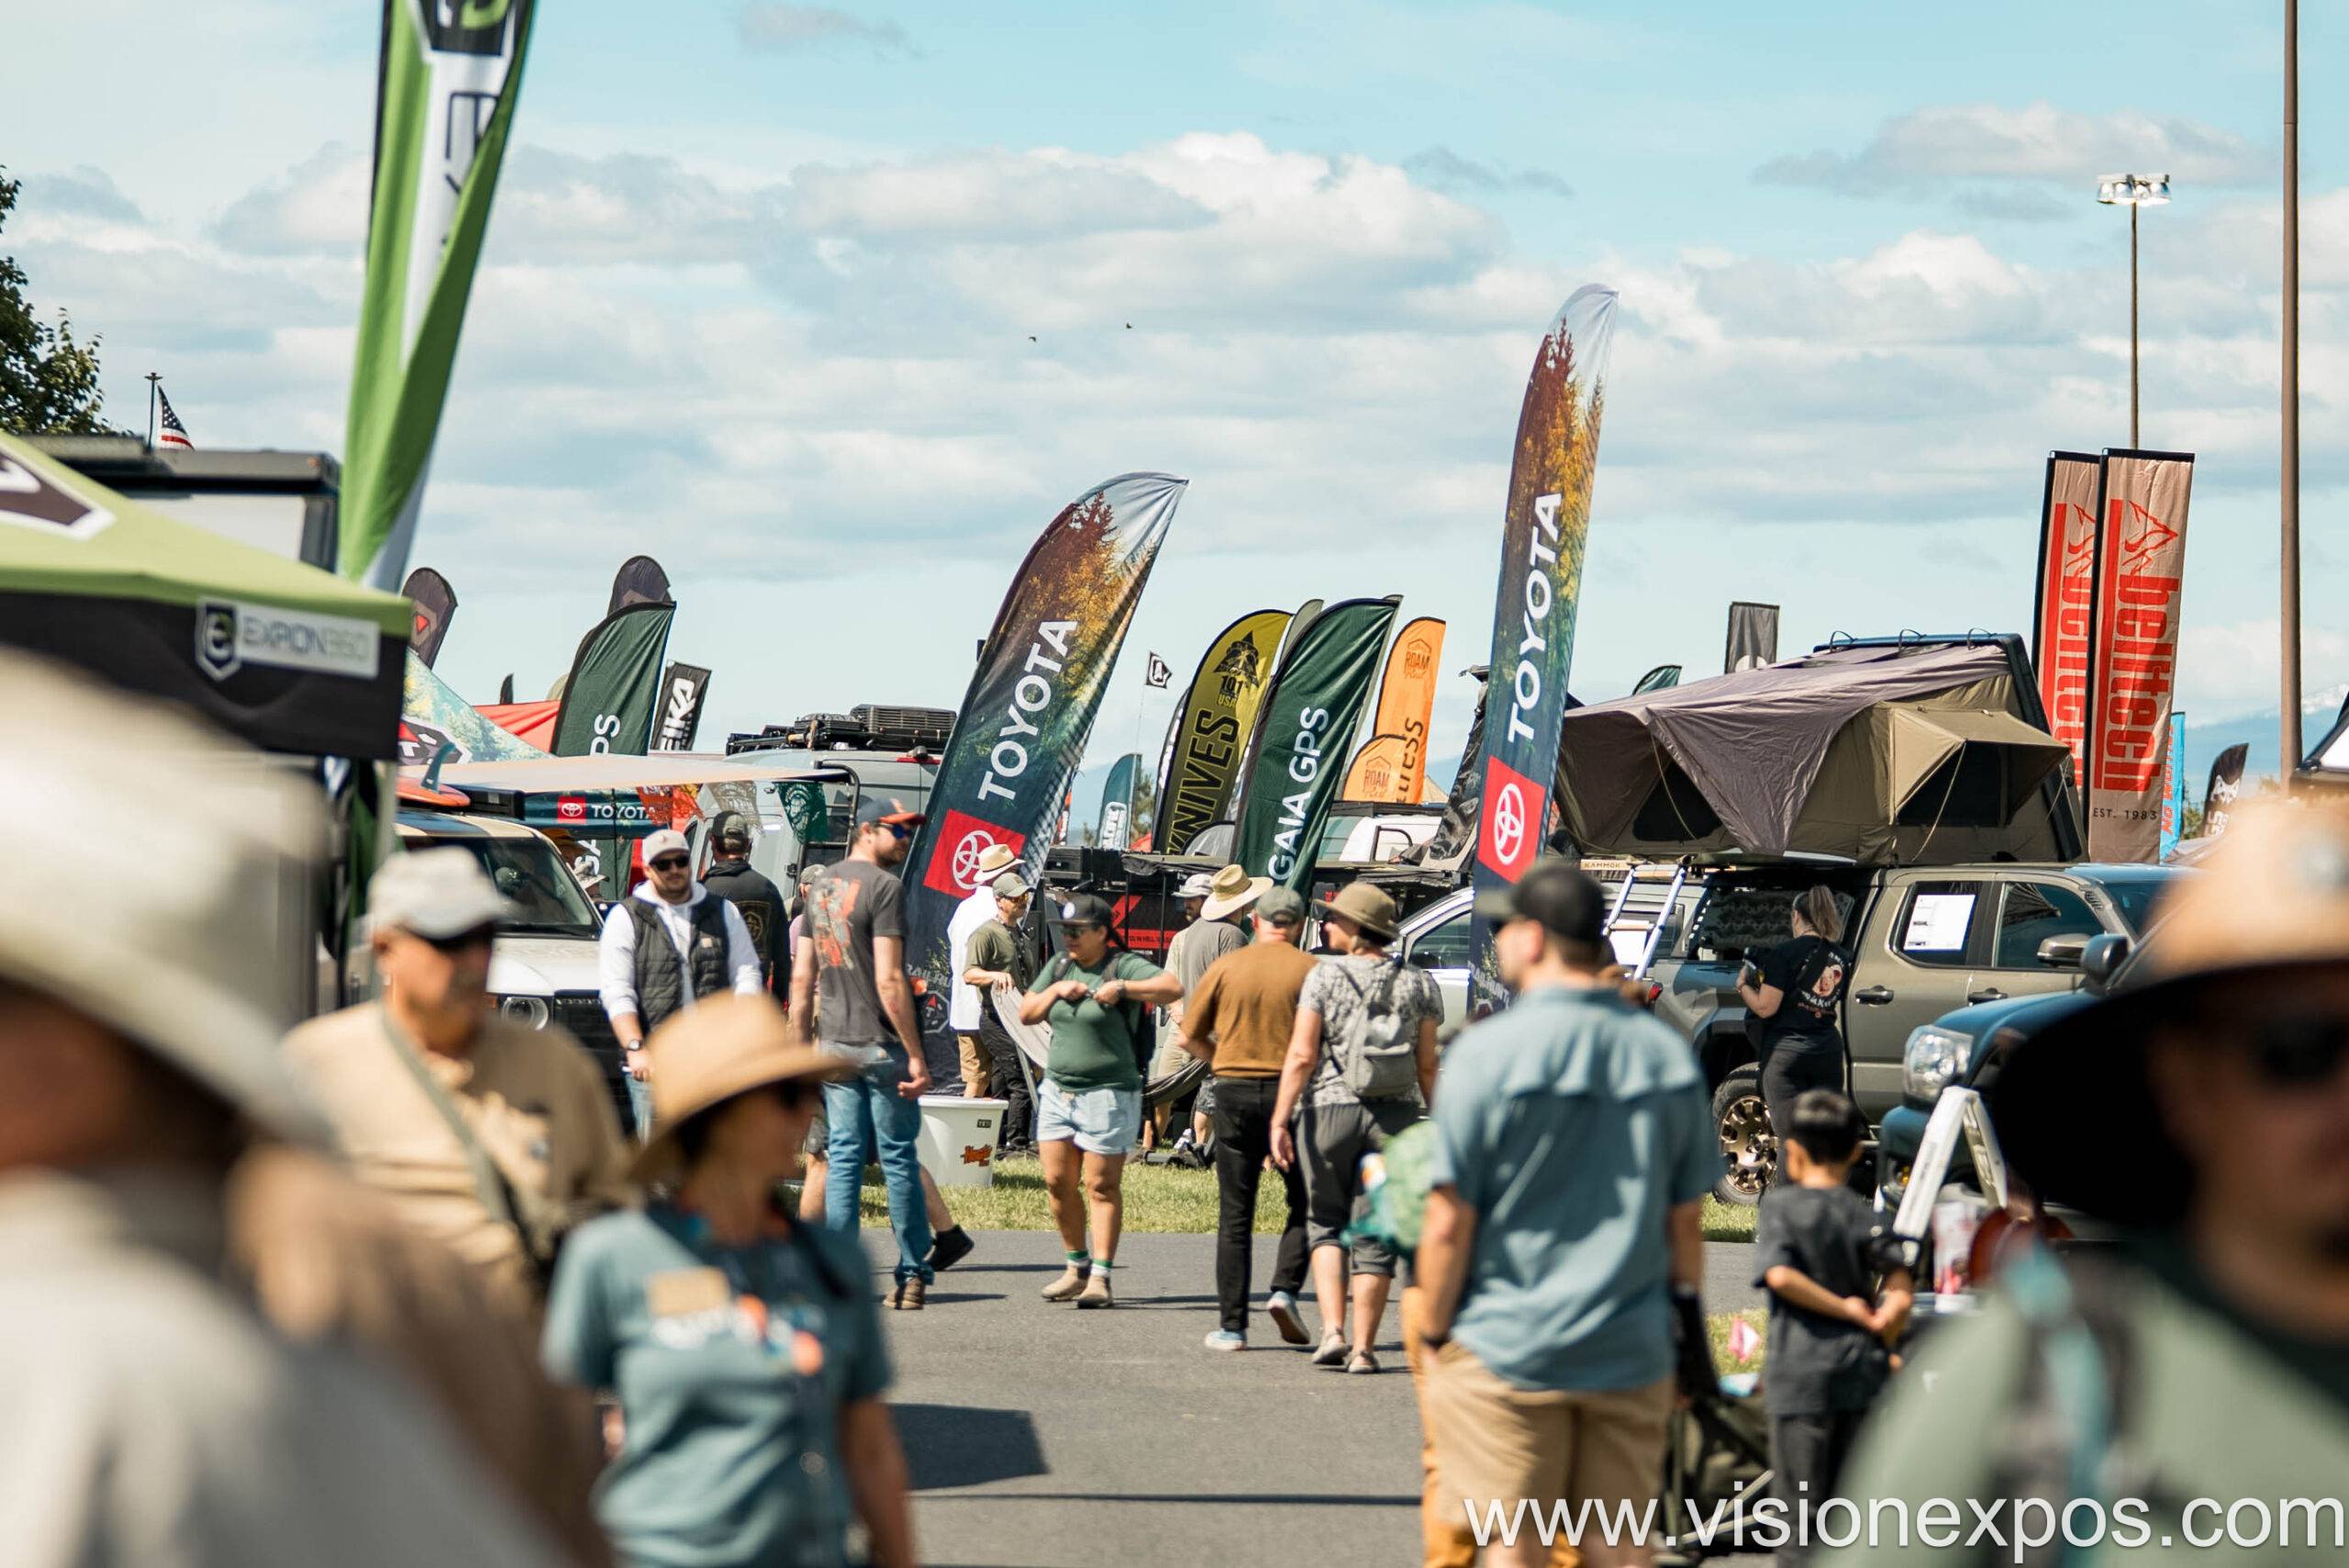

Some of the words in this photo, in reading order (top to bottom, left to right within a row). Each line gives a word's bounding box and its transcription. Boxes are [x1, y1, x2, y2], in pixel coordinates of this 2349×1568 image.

[1508, 493, 1562, 743] TOYOTA
[2104, 573, 2179, 792] belltech
[977, 621, 1078, 800] TOYOTA
[1289, 706, 1329, 783] GPS
[1268, 791, 1312, 880] GAIA
[2092, 807, 2117, 819] EST.
[2124, 807, 2157, 820] 1983
